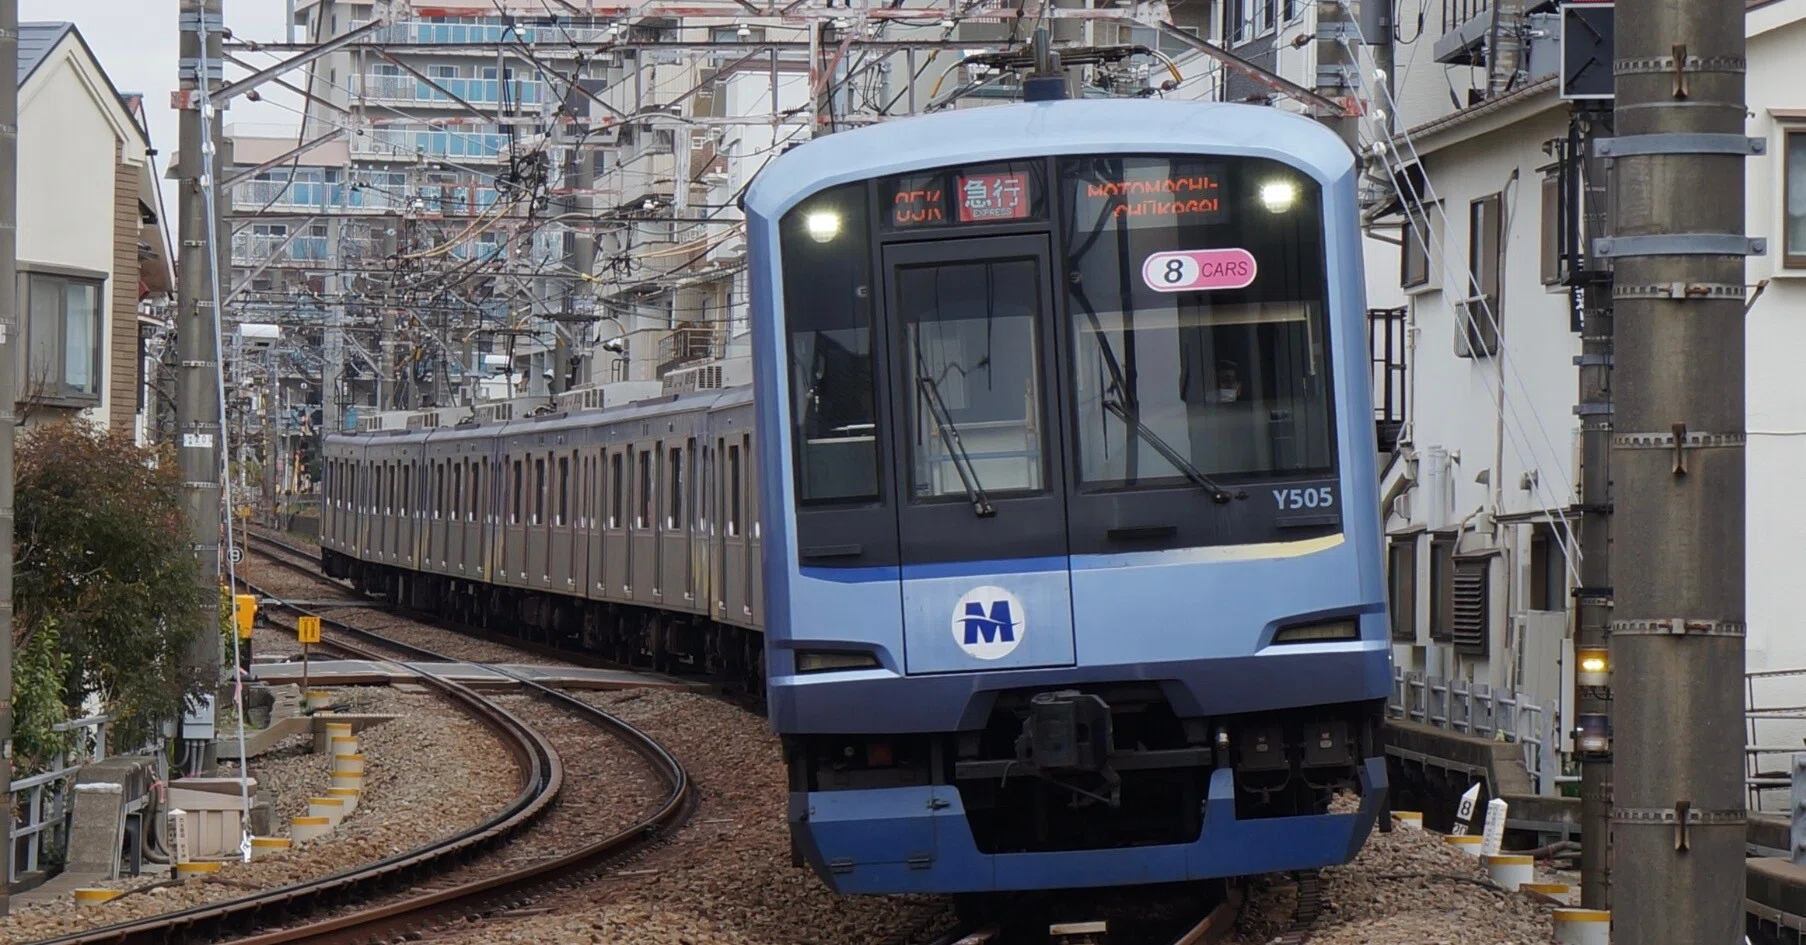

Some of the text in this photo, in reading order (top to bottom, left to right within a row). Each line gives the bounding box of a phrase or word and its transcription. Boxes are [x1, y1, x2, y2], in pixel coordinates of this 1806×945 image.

[963, 178, 1020, 208] 急行
[972, 207, 1012, 217] EXPRESS
[1164, 259, 1248, 283] 8 CARS
[1272, 487, 1333, 510] Y505
[964, 600, 1015, 645] M
[1460, 801, 1472, 816] 8
